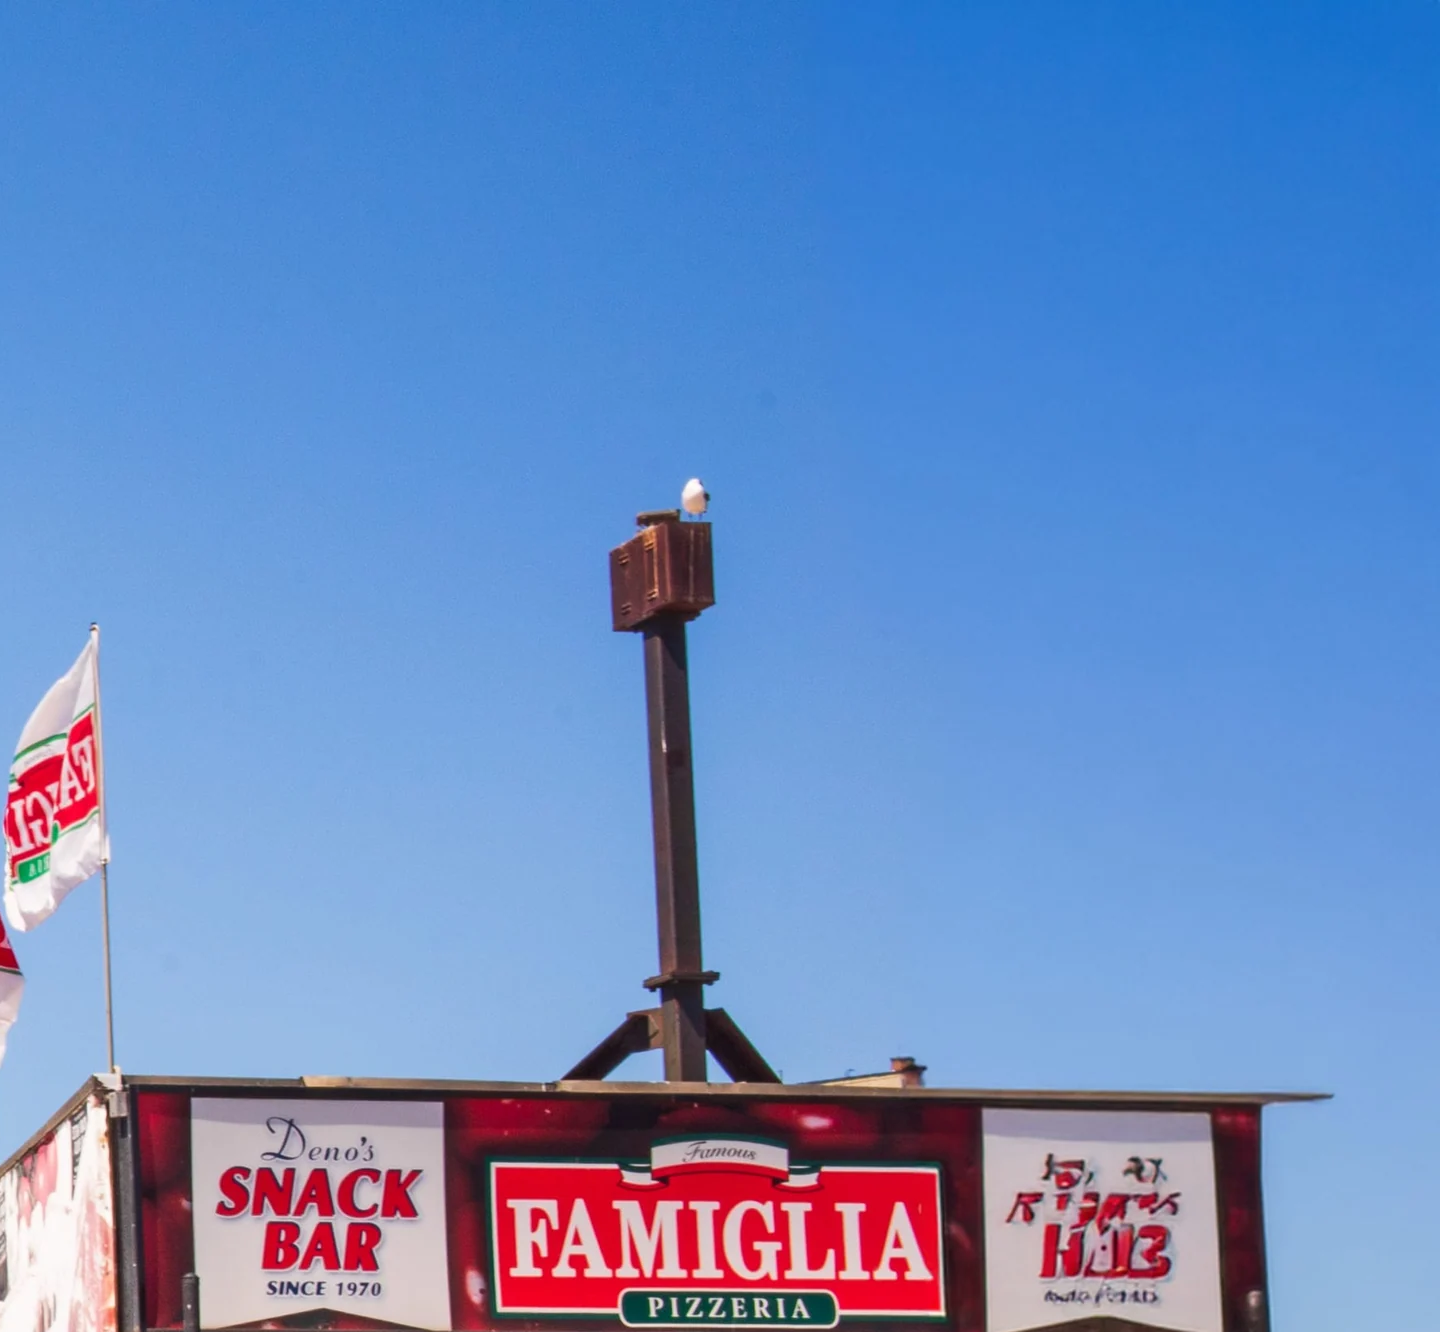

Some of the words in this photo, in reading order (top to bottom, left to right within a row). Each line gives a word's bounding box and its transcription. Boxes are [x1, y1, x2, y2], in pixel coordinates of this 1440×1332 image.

[261, 1116, 375, 1161] Deno's
[682, 1139, 758, 1163] Famous
[215, 1165, 423, 1219] SNACK
[261, 1220, 382, 1272] BAR
[507, 1198, 933, 1281] FAMIGLIA
[266, 1280, 327, 1297] SINCE
[336, 1281, 382, 1297] 1970
[648, 1296, 811, 1320] PIZZERIA
